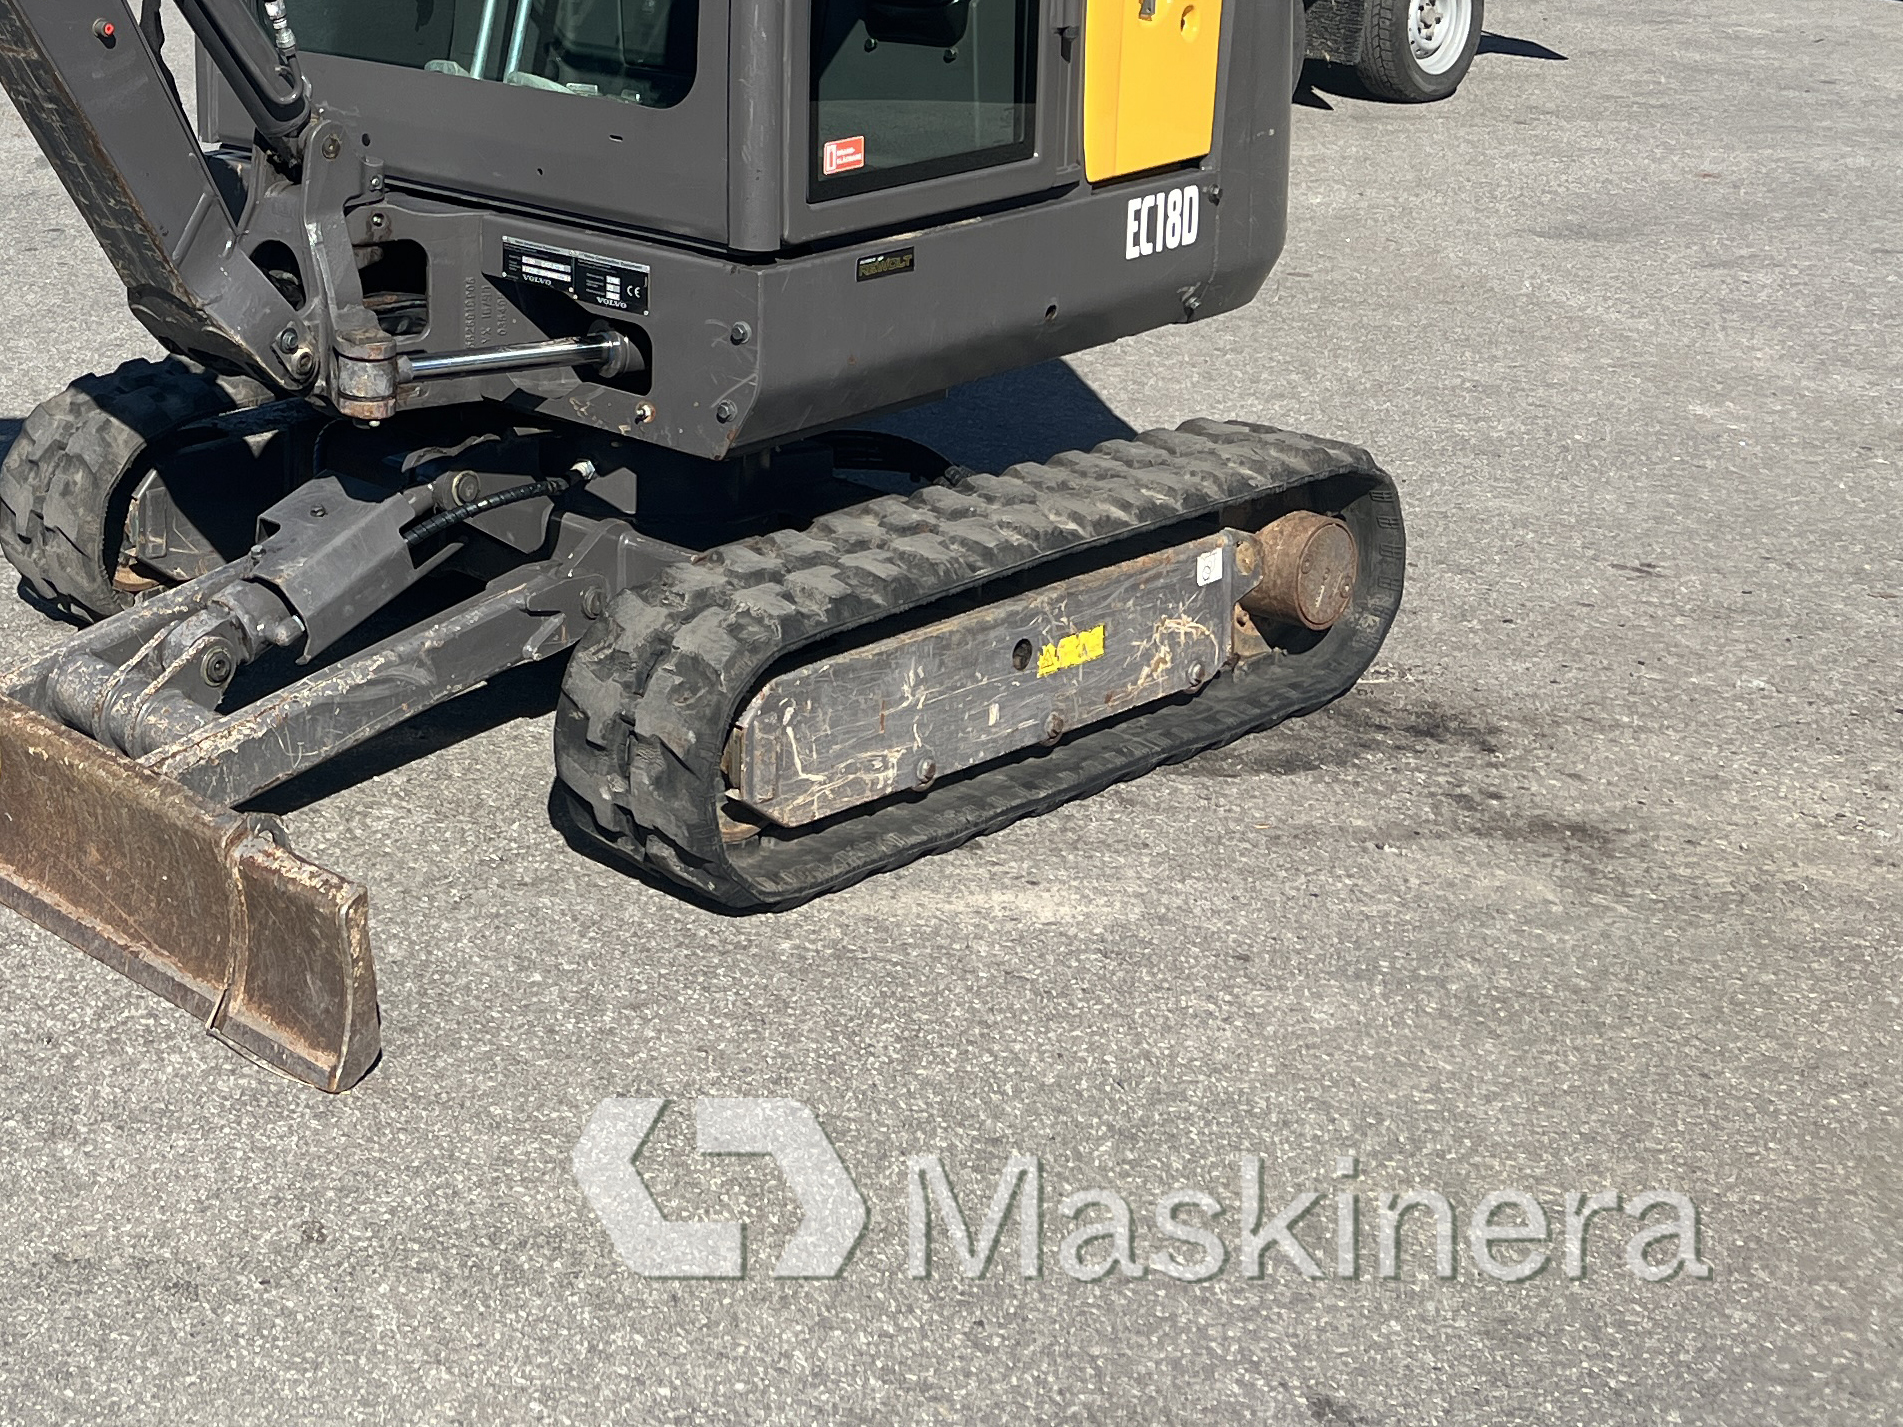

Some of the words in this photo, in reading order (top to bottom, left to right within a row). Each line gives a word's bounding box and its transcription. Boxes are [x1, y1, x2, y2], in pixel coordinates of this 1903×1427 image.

[1125, 184, 1200, 261] EC18D
[522, 273, 552, 286] VOLVO
[596, 296, 627, 309] VOLVO
